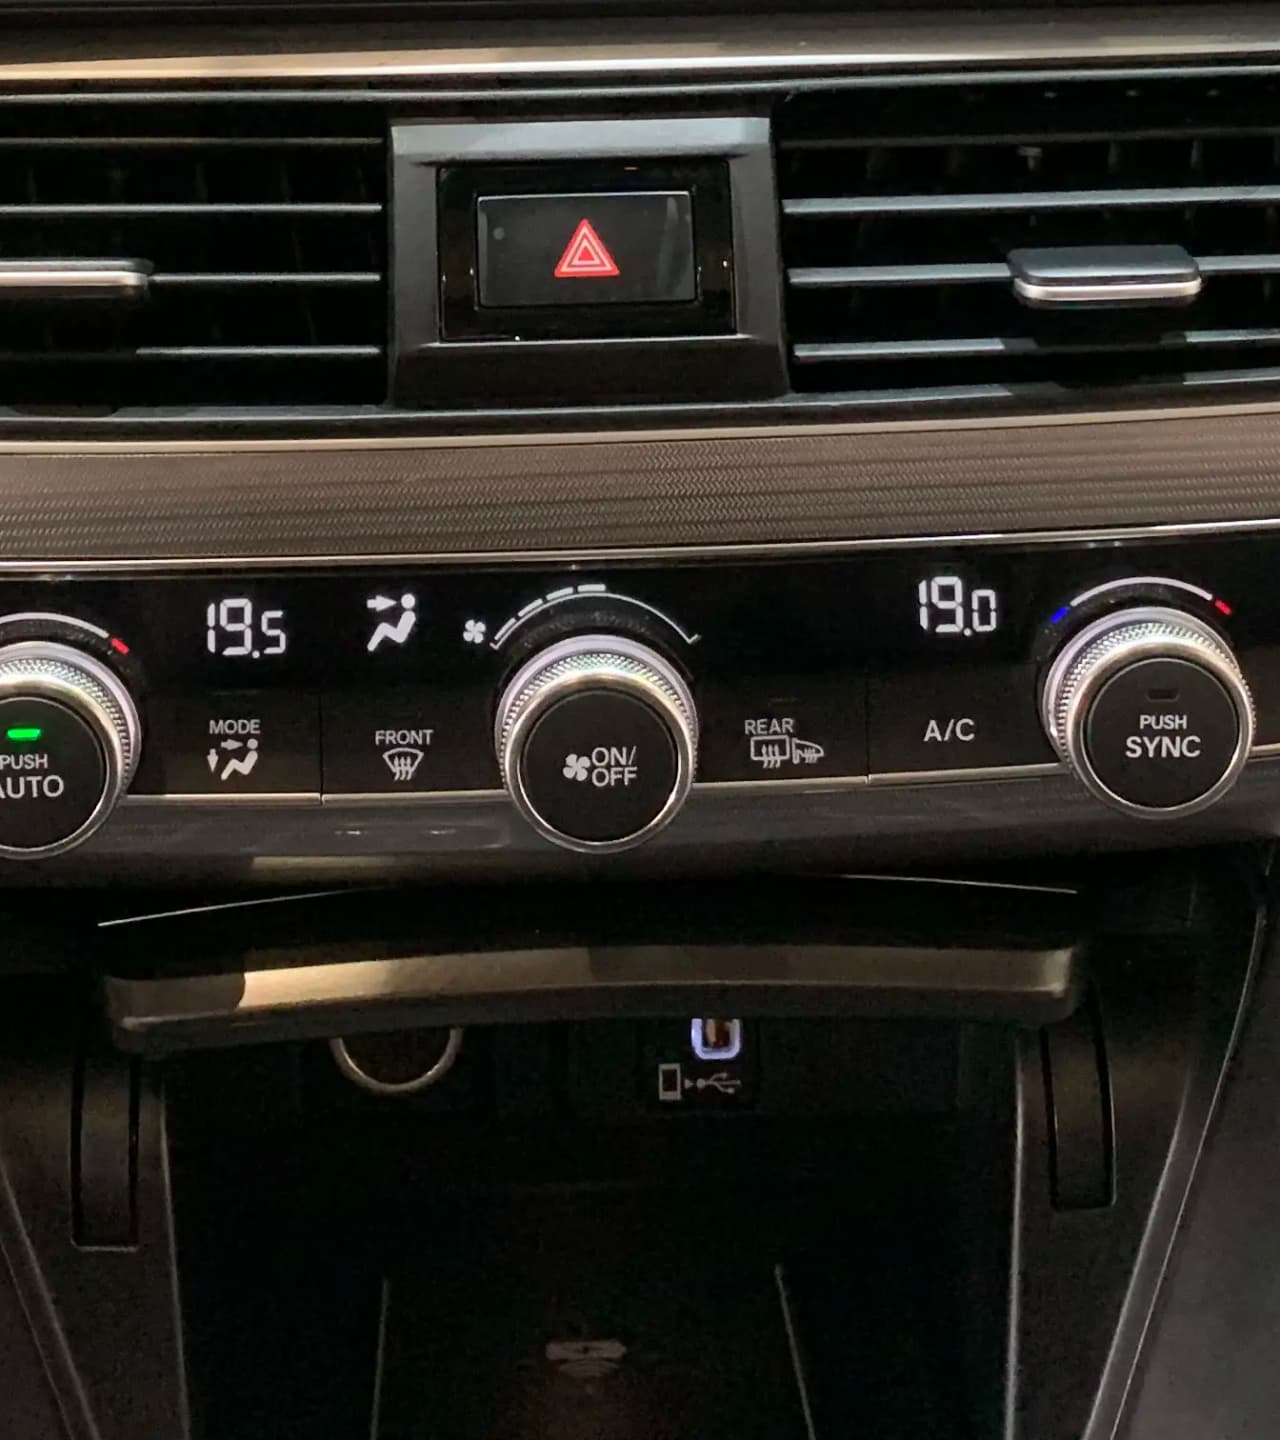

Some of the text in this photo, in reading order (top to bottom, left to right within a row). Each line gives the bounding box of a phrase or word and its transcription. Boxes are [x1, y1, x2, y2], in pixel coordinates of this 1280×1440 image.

[918, 575, 997, 637] 19.0
[206, 597, 287, 659] 19.5
[209, 719, 261, 735] MODE
[744, 718, 795, 735] REAR
[923, 718, 975, 743] A/C
[1138, 714, 1188, 730] PUSH
[375, 729, 434, 747] FRONT
[1125, 735, 1201, 760] SYNC
[591, 745, 638, 767] ON/
[591, 767, 638, 788] OFF
